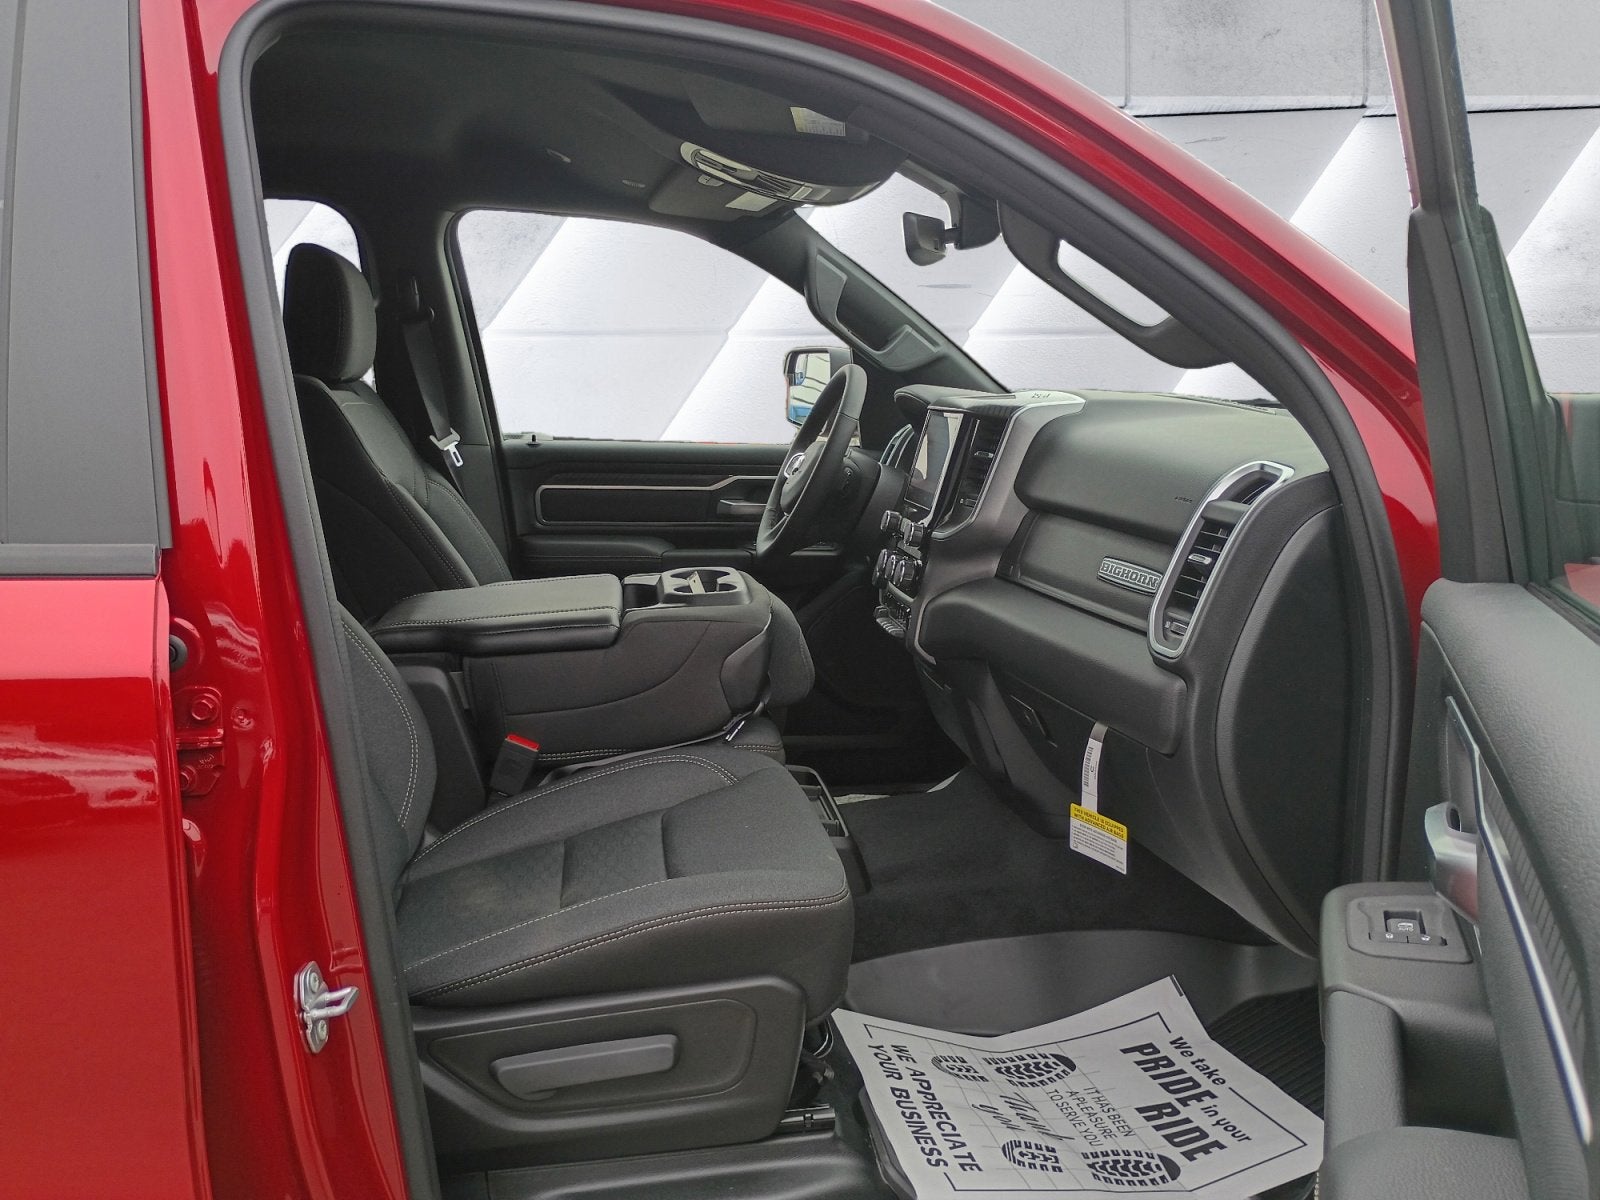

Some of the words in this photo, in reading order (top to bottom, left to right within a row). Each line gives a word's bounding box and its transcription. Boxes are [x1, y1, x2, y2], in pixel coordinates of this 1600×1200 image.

[1169, 1036, 1194, 1058] We
[1190, 1058, 1226, 1085] take
[868, 1045, 903, 1080] YOUR
[890, 1087, 948, 1167] BUSINESS
[891, 1045, 917, 1063] WE
[905, 1067, 983, 1171] APPRECIATE
[1000, 1091, 1075, 1141] Thank
[1065, 1090, 1079, 1098] A
[1075, 1096, 1118, 1140] PLEASURE
[1084, 1087, 1100, 1095] IT
[1091, 1096, 1115, 1114] HAS
[1120, 1042, 1218, 1107] PRIDE
[1200, 1104, 1219, 1117] in
[1211, 1118, 1252, 1142] your
[1047, 1088, 1064, 1102] TO
[1056, 1100, 1087, 1129] SERVE
[1081, 1128, 1104, 1147] YOU
[1108, 1113, 1136, 1137] BEEN
[1134, 1102, 1227, 1162] RIDE
